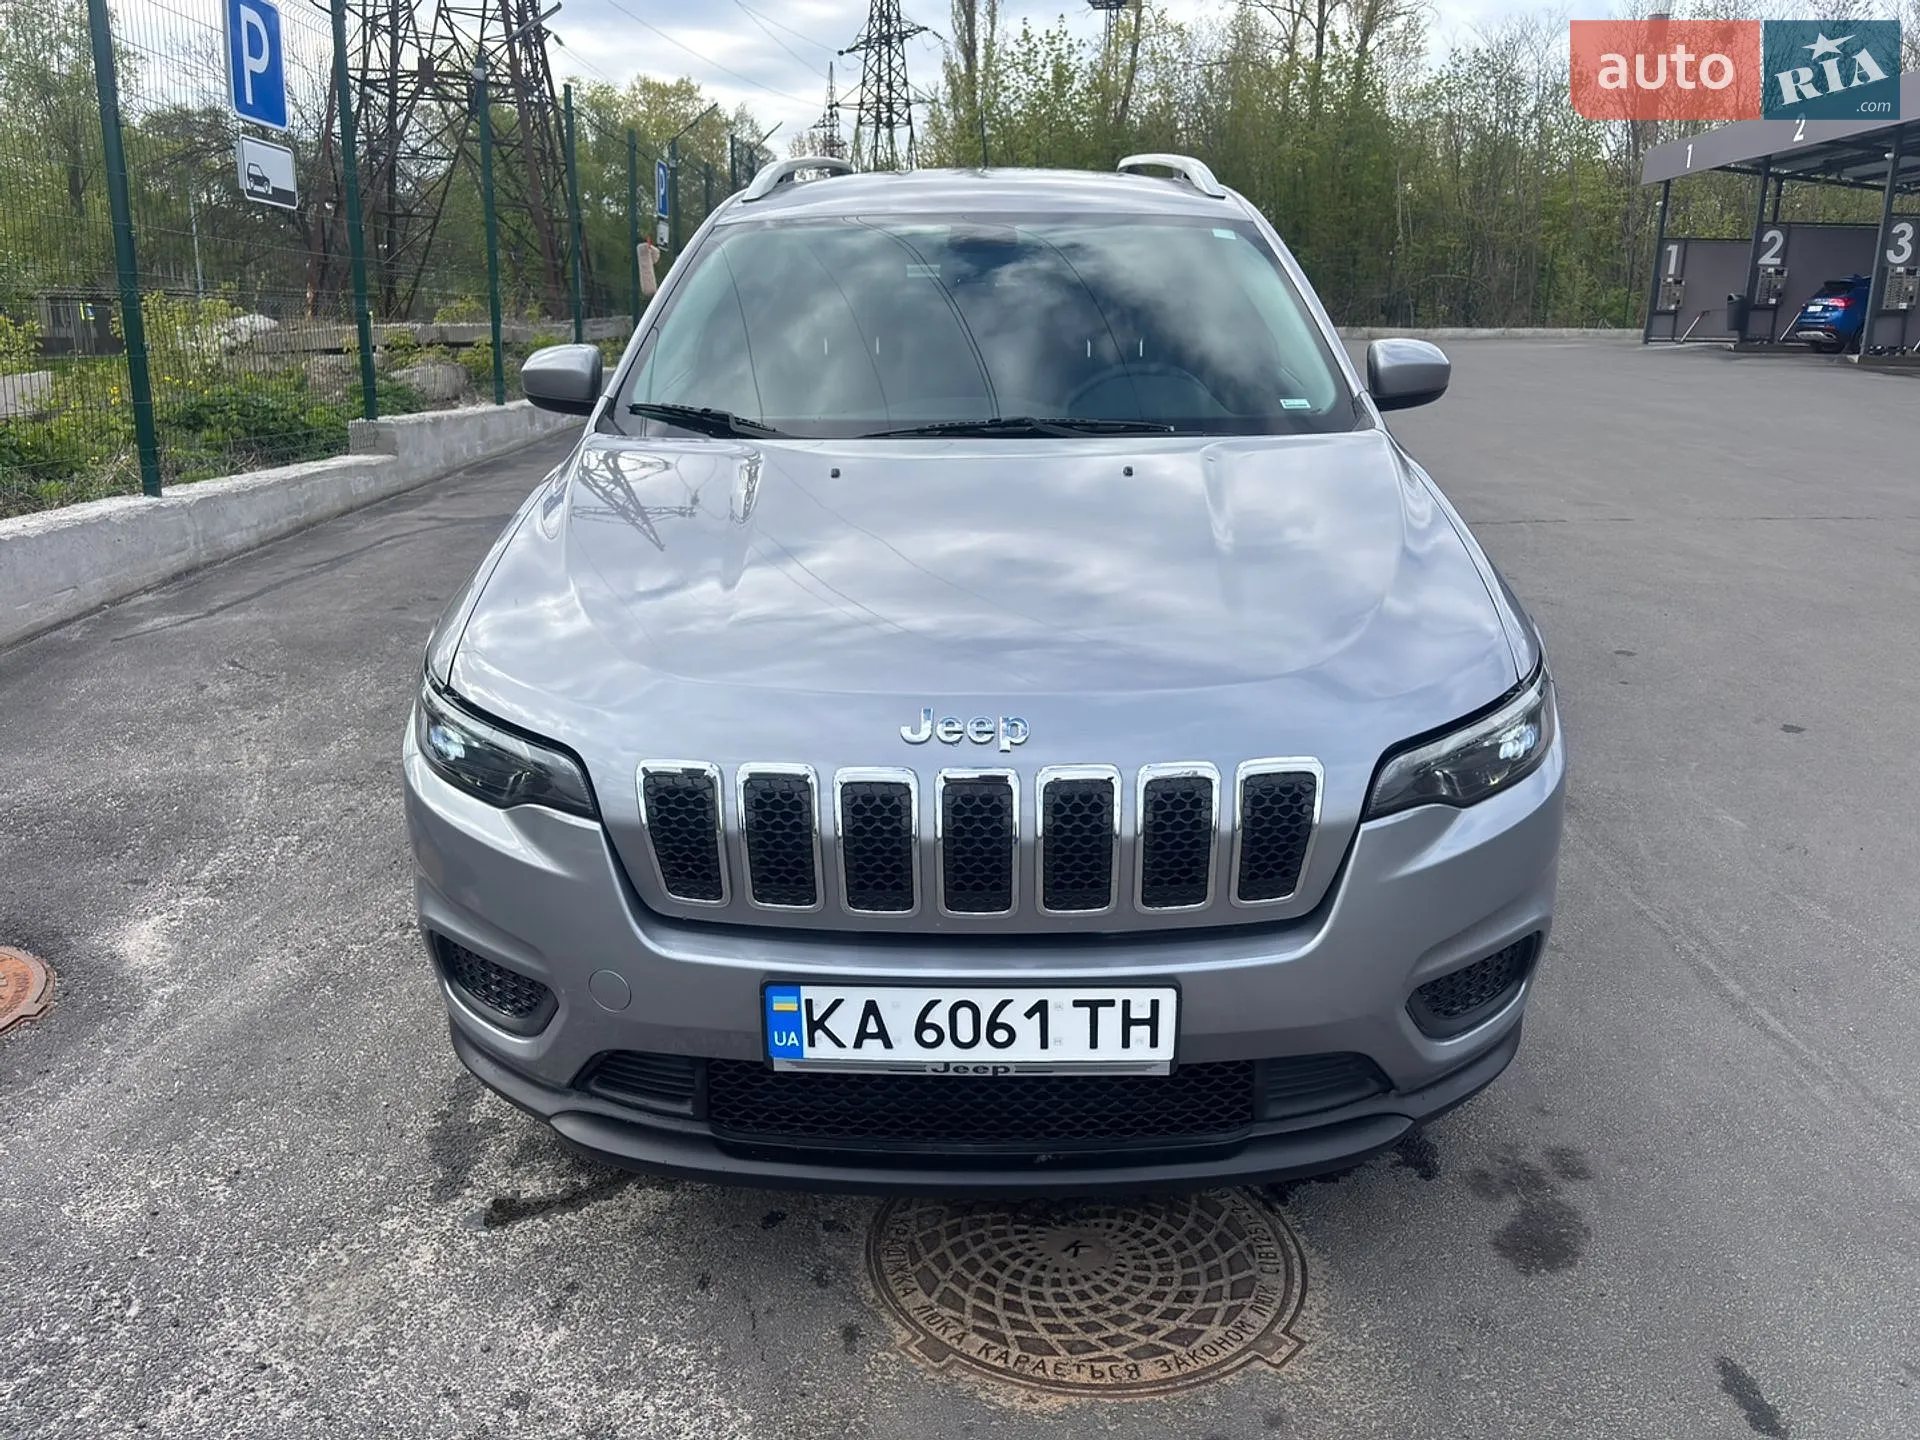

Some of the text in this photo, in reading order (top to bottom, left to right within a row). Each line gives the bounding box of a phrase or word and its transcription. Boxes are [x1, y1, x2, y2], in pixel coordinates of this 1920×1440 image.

[240, 4, 269, 105] P
[1794, 112, 1805, 141] 2
[1686, 143, 1694, 169] 1
[1667, 244, 1678, 275] 1
[1757, 230, 1784, 265] 2
[1886, 222, 1914, 264] 3
[900, 708, 1030, 752] Jeep
[774, 1031, 800, 1047] UA
[804, 998, 1160, 1050] KA 6061 TH
[931, 1062, 1011, 1078] Jeep
[913, 1304, 970, 1346] ЛЮКА
[977, 1342, 1141, 1381] КАРАЄТЬСЯ
[1154, 1318, 1257, 1374] ЗАКОНОМ
